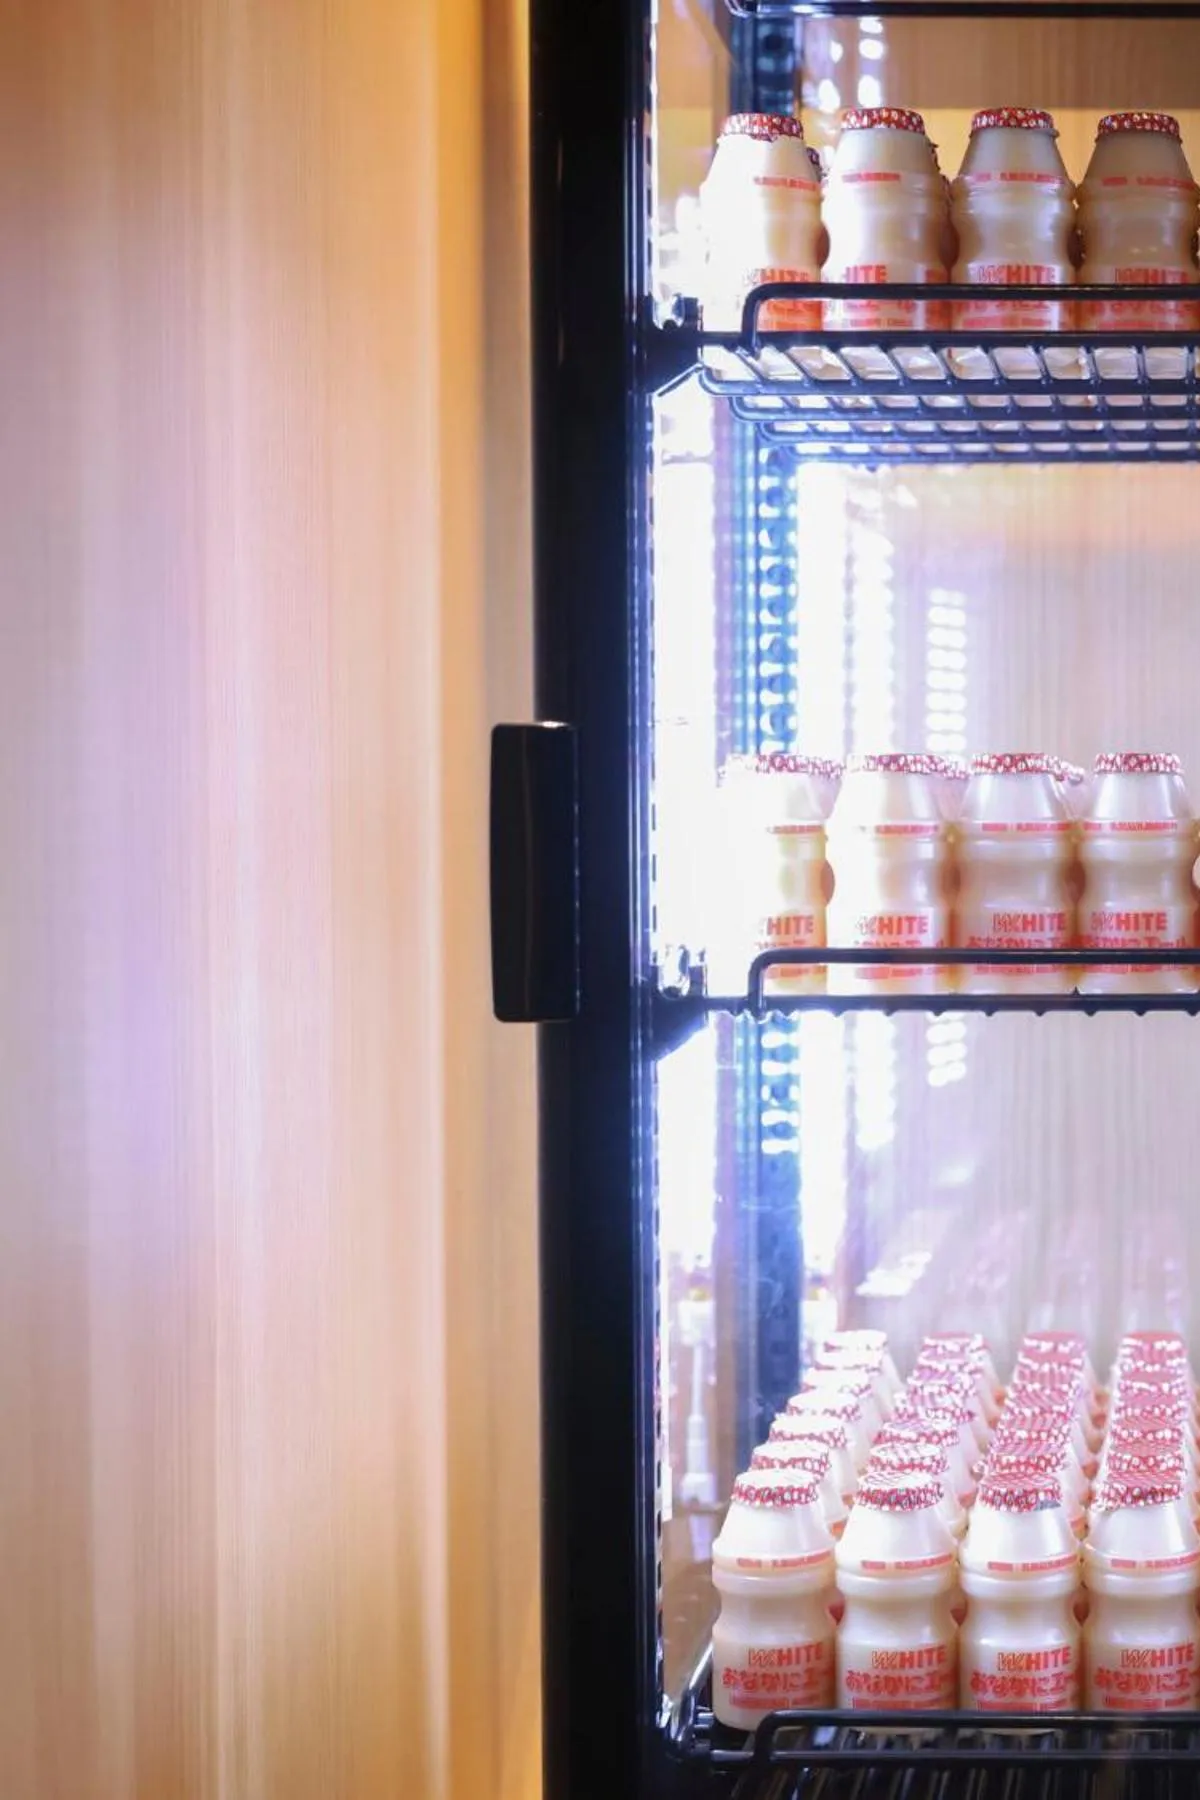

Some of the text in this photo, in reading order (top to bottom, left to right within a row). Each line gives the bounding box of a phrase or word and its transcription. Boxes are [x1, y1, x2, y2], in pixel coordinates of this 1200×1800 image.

[992, 912, 1067, 933] WHITE
[1091, 911, 1168, 931] WHITE
[748, 1641, 823, 1667] WHITE
[871, 1644, 947, 1670] WHITE
[997, 1645, 1071, 1671] WHITE
[1120, 1641, 1194, 1668] WHITE
